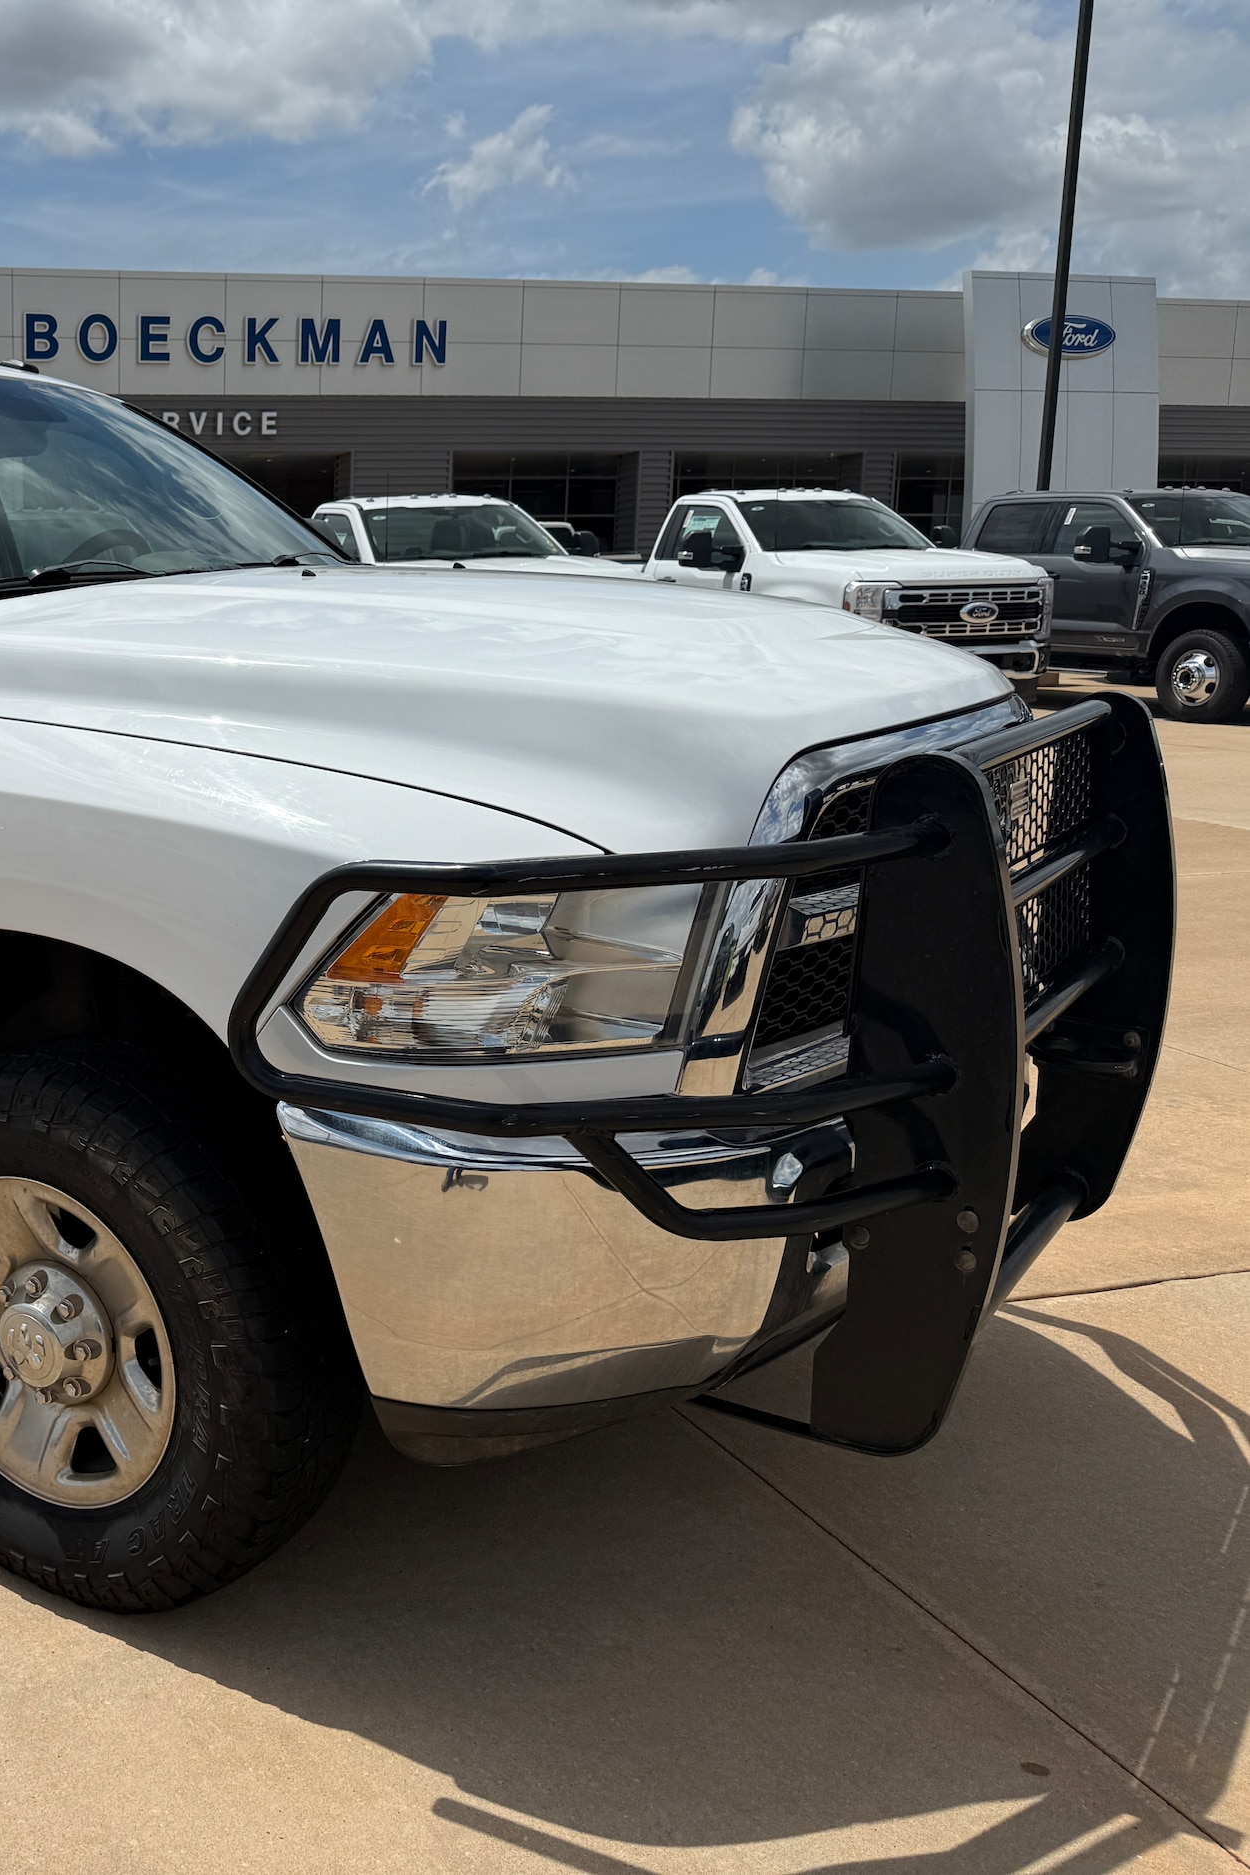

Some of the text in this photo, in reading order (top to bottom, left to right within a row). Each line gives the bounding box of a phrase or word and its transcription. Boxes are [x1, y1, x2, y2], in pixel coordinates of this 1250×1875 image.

[24, 313, 448, 366] BOECKMAN
[1062, 321, 1099, 347] Ford
[150, 411, 278, 436] RVICE
[971, 607, 992, 618] Ford
[127, 1467, 198, 1557] TRAC
